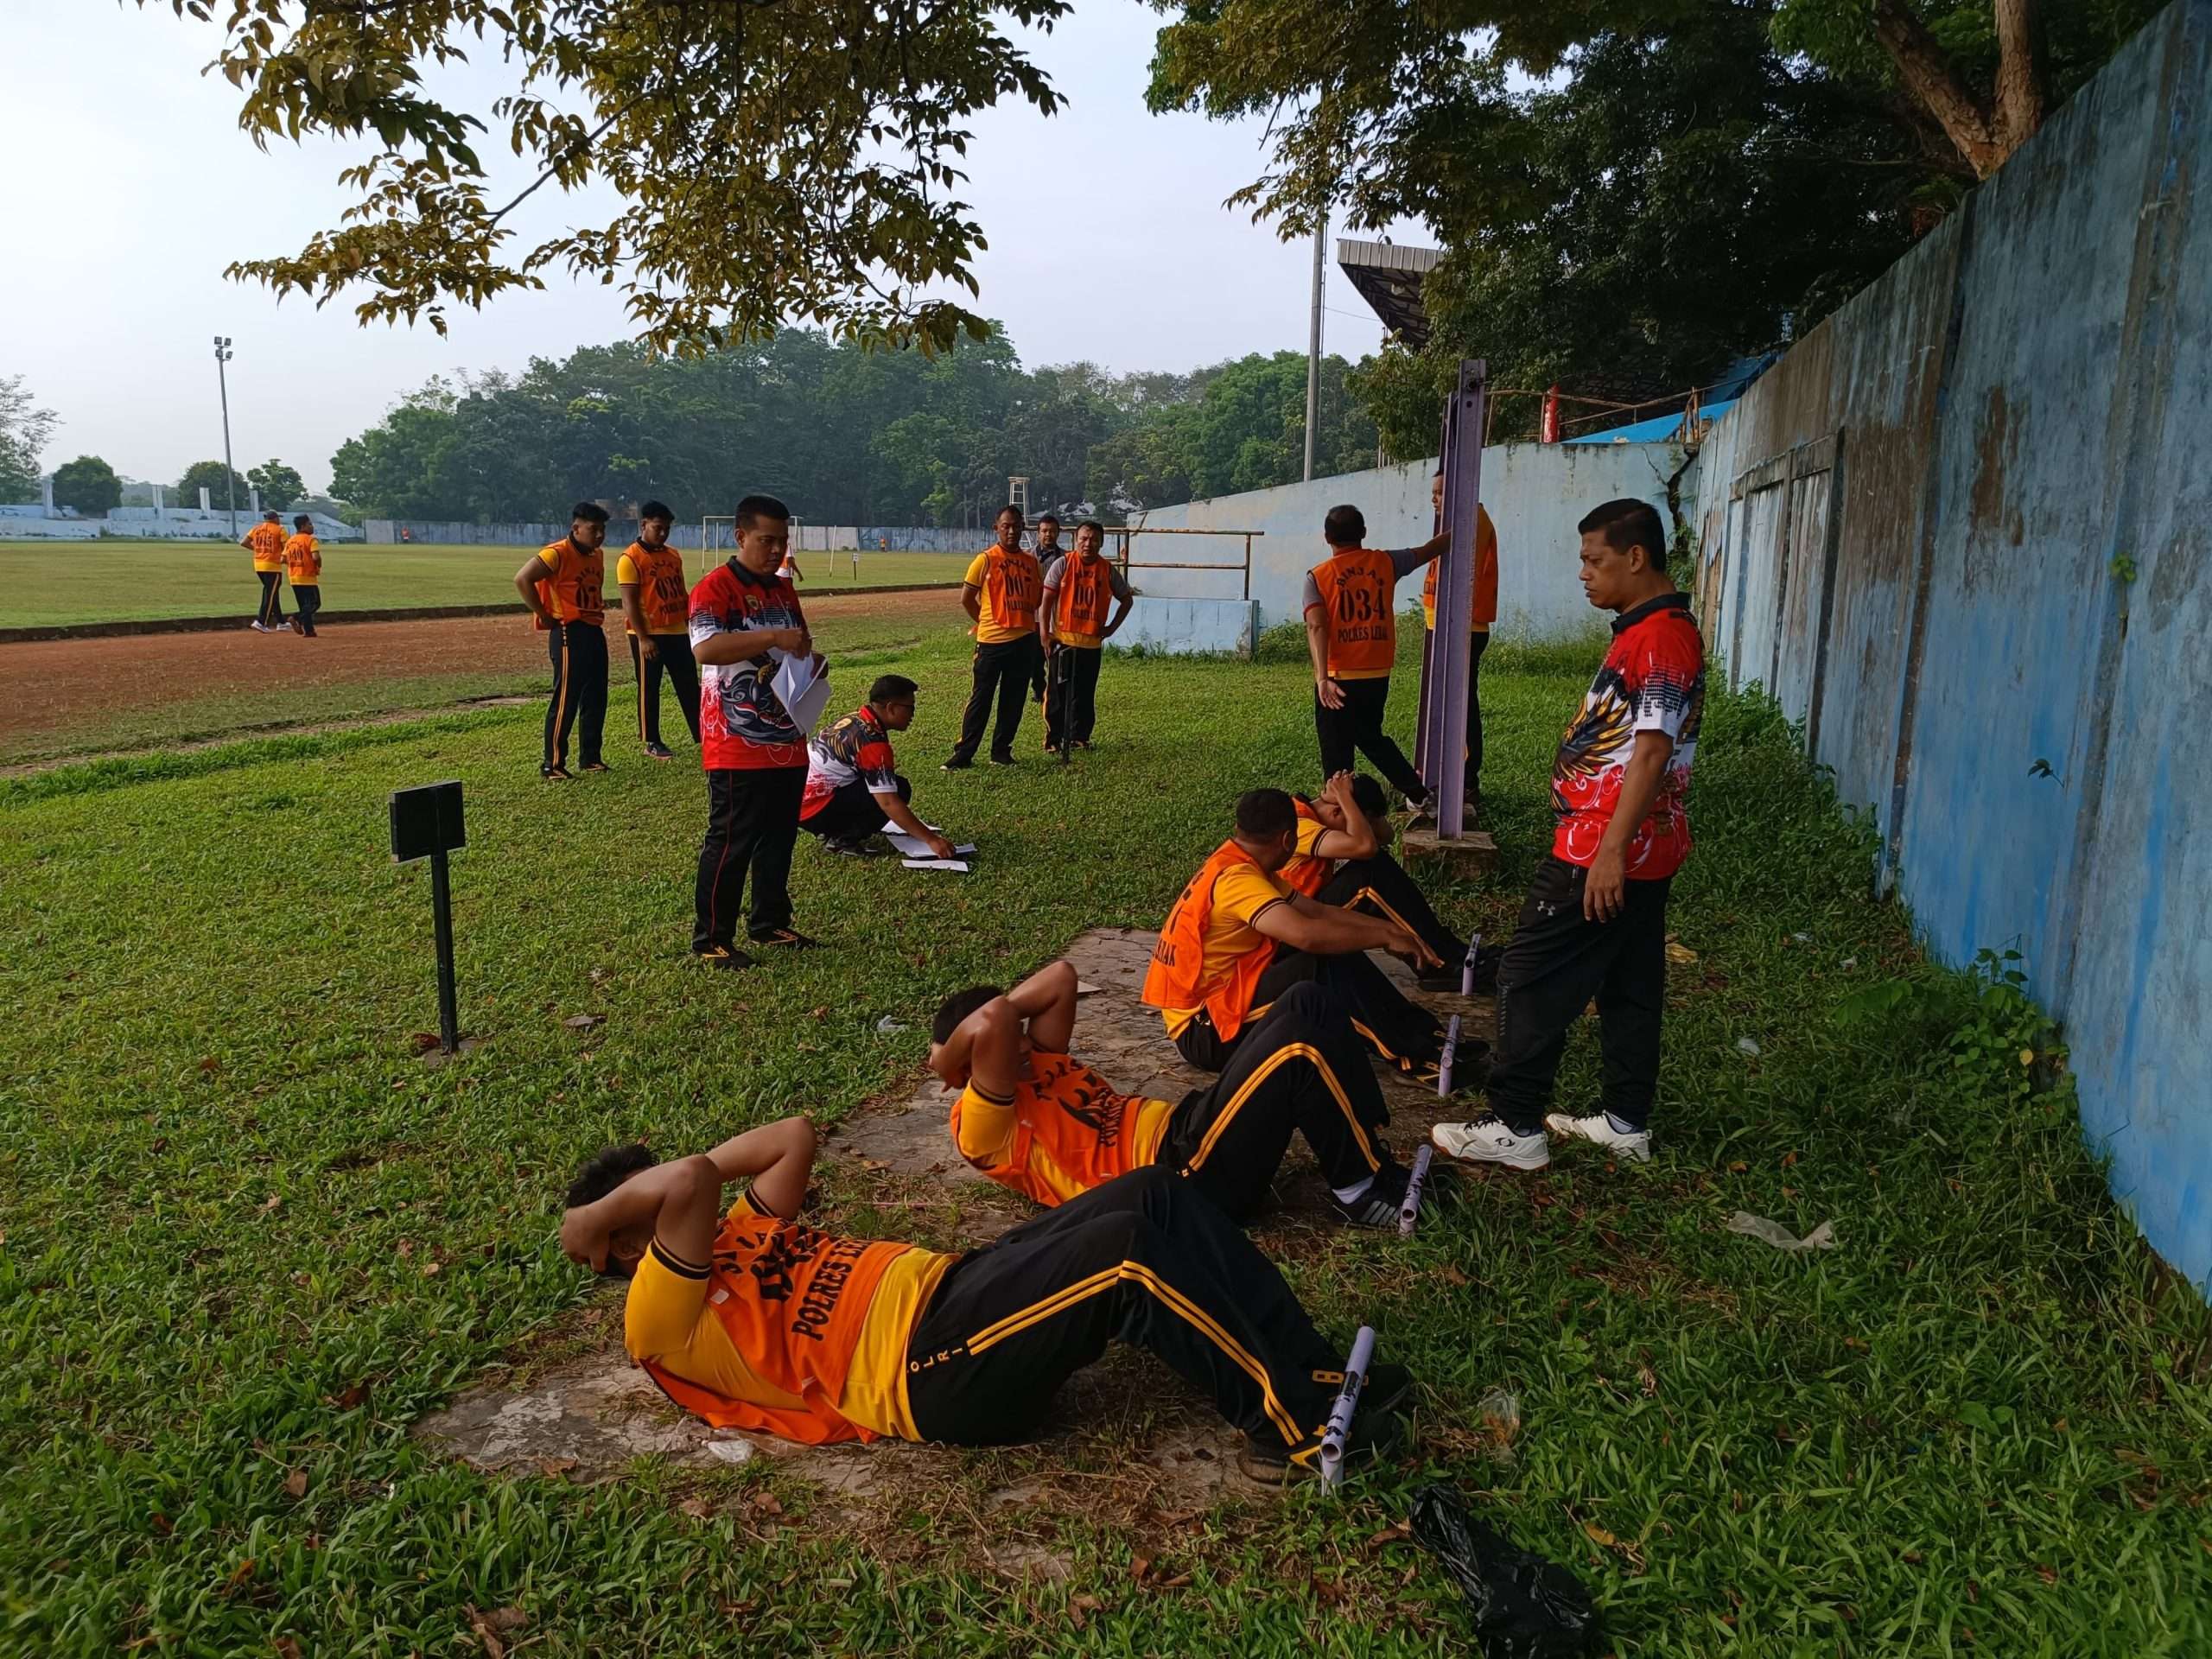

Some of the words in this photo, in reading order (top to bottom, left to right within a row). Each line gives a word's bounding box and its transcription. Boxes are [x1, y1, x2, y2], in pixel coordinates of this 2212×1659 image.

[1340, 588, 1386, 623] 034
[791, 1260, 853, 1341] POLRES
[910, 1347, 963, 1372] OLRI
